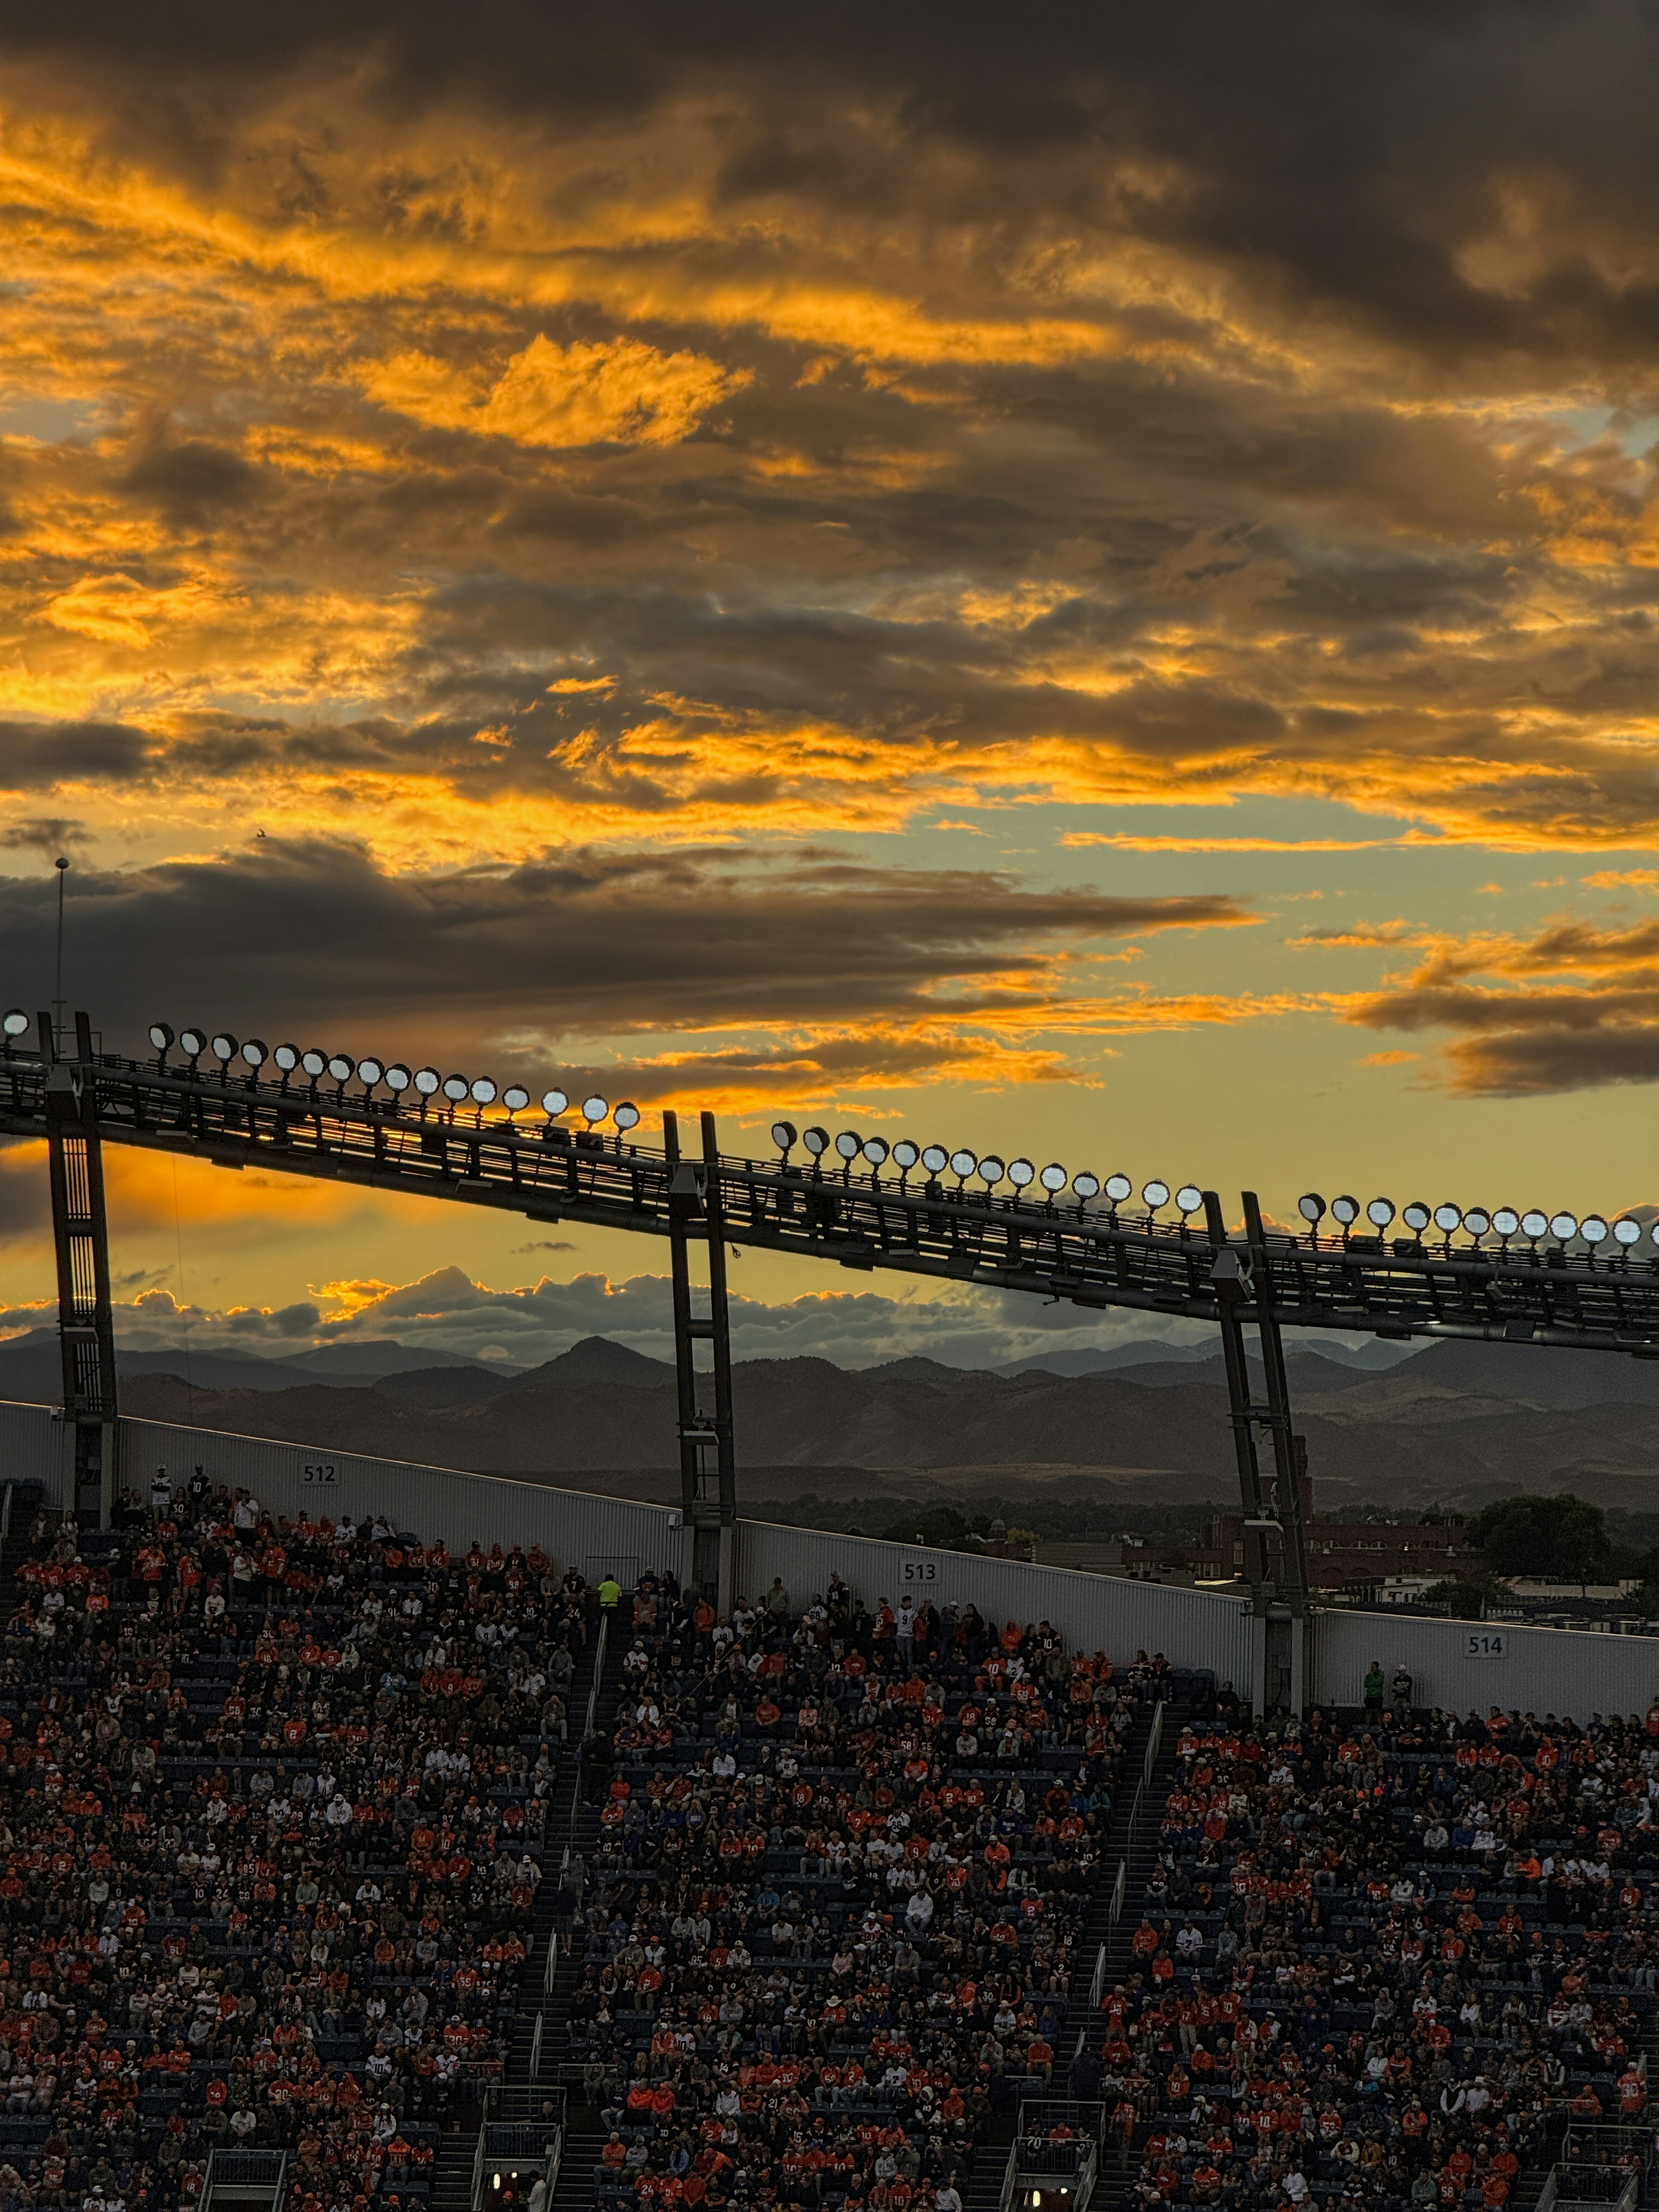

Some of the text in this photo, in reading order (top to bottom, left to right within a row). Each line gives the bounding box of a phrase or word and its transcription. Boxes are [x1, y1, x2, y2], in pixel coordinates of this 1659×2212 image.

[304, 1466, 335, 1481] 512
[193, 1482, 201, 1492] 10
[173, 1504, 184, 1513] 30
[471, 1558, 479, 1566] 31
[905, 1564, 935, 1579] 513
[75, 1574, 82, 1584] 2
[572, 1581, 577, 1590] 7
[388, 1608, 396, 1617] 91
[810, 1611, 820, 1620] 58
[902, 1615, 907, 1625] 9
[1044, 1639, 1052, 1649] 10
[1469, 1637, 1503, 1653] 514
[988, 1664, 998, 1674] 10
[229, 1706, 240, 1714] 58
[967, 1713, 975, 1721] 18
[419, 1731, 425, 1741] 2
[901, 1741, 911, 1750] 58
[1345, 1752, 1351, 1761] 2
[797, 1793, 804, 1803] 18
[946, 1793, 953, 1803] 2
[855, 1818, 860, 1827] 7
[442, 1839, 450, 1849] 10
[603, 1843, 611, 1852] 10
[913, 1847, 919, 1858] 9
[59, 1861, 65, 1870] 2
[477, 1866, 486, 1875] 10
[895, 1877, 899, 1886] 1
[195, 1889, 204, 1899] 10
[1028, 1906, 1035, 1916] 2
[1064, 1936, 1072, 1945] 18
[1447, 1950, 1454, 1959] 18
[1058, 1964, 1064, 1973] 2
[644, 1979, 650, 1989] 2
[983, 1991, 993, 2000] 30
[1224, 2002, 1232, 2013] 10
[703, 2015, 712, 2023] 18
[449, 2036, 462, 2045] 30
[375, 2064, 383, 2073] 10
[720, 2063, 729, 2073] 14
[849, 2072, 854, 2081] 2
[913, 2079, 921, 2088] 10
[1172, 2082, 1180, 2092] 10
[768, 2098, 777, 2108] 21
[707, 2131, 713, 2140] 2
[793, 2131, 803, 2143] 15
[930, 2136, 942, 2146] 53
[1389, 2155, 1397, 2165] 10
[642, 2185, 653, 2194] 24
[1442, 2186, 1453, 2197] 58
[894, 2196, 904, 2206] 10
